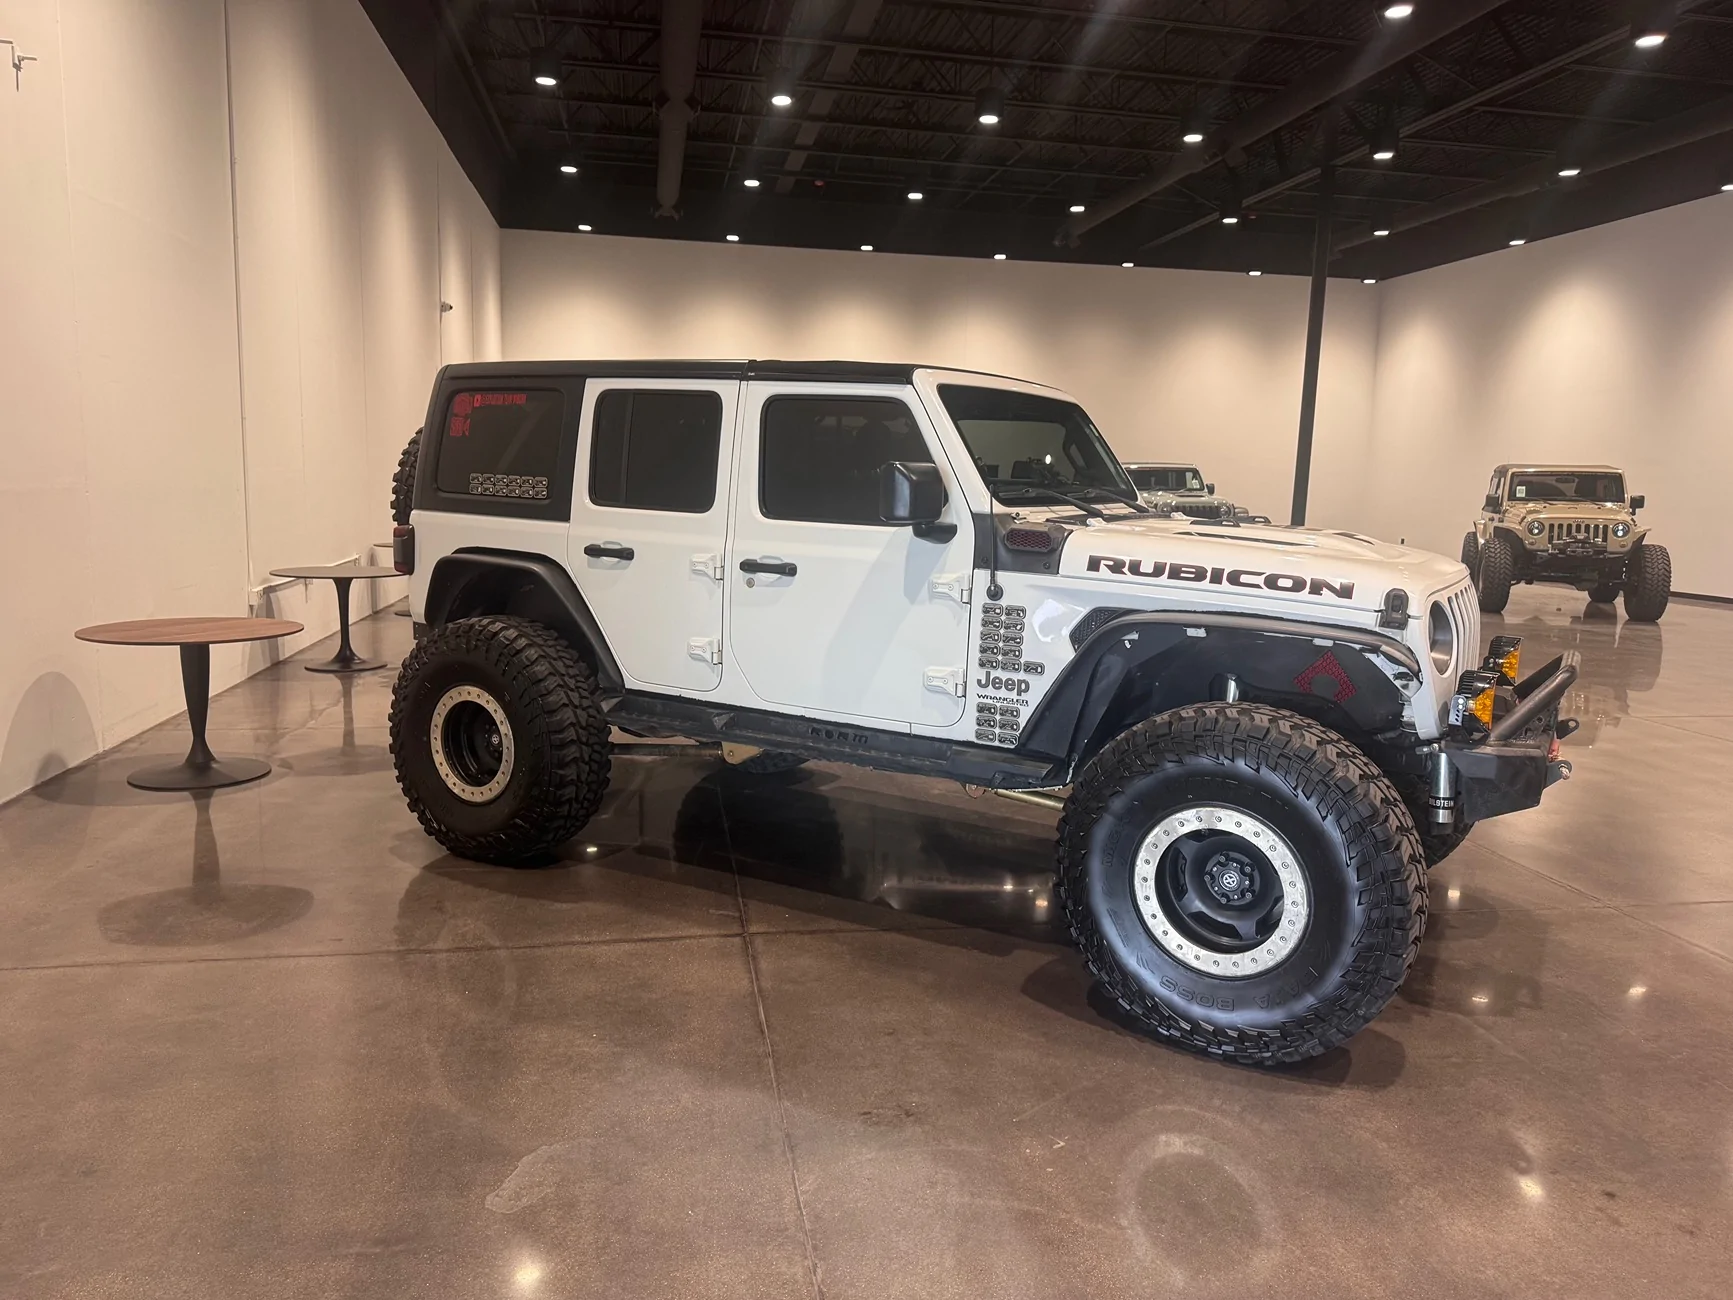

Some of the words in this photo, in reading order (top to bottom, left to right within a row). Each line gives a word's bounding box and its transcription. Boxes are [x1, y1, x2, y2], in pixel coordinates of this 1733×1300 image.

[1086, 554, 1355, 600] RUBICON
[976, 670, 1030, 697] Jeep
[976, 693, 1029, 705] WRANGLER
[1159, 975, 1235, 1011] BOSS
